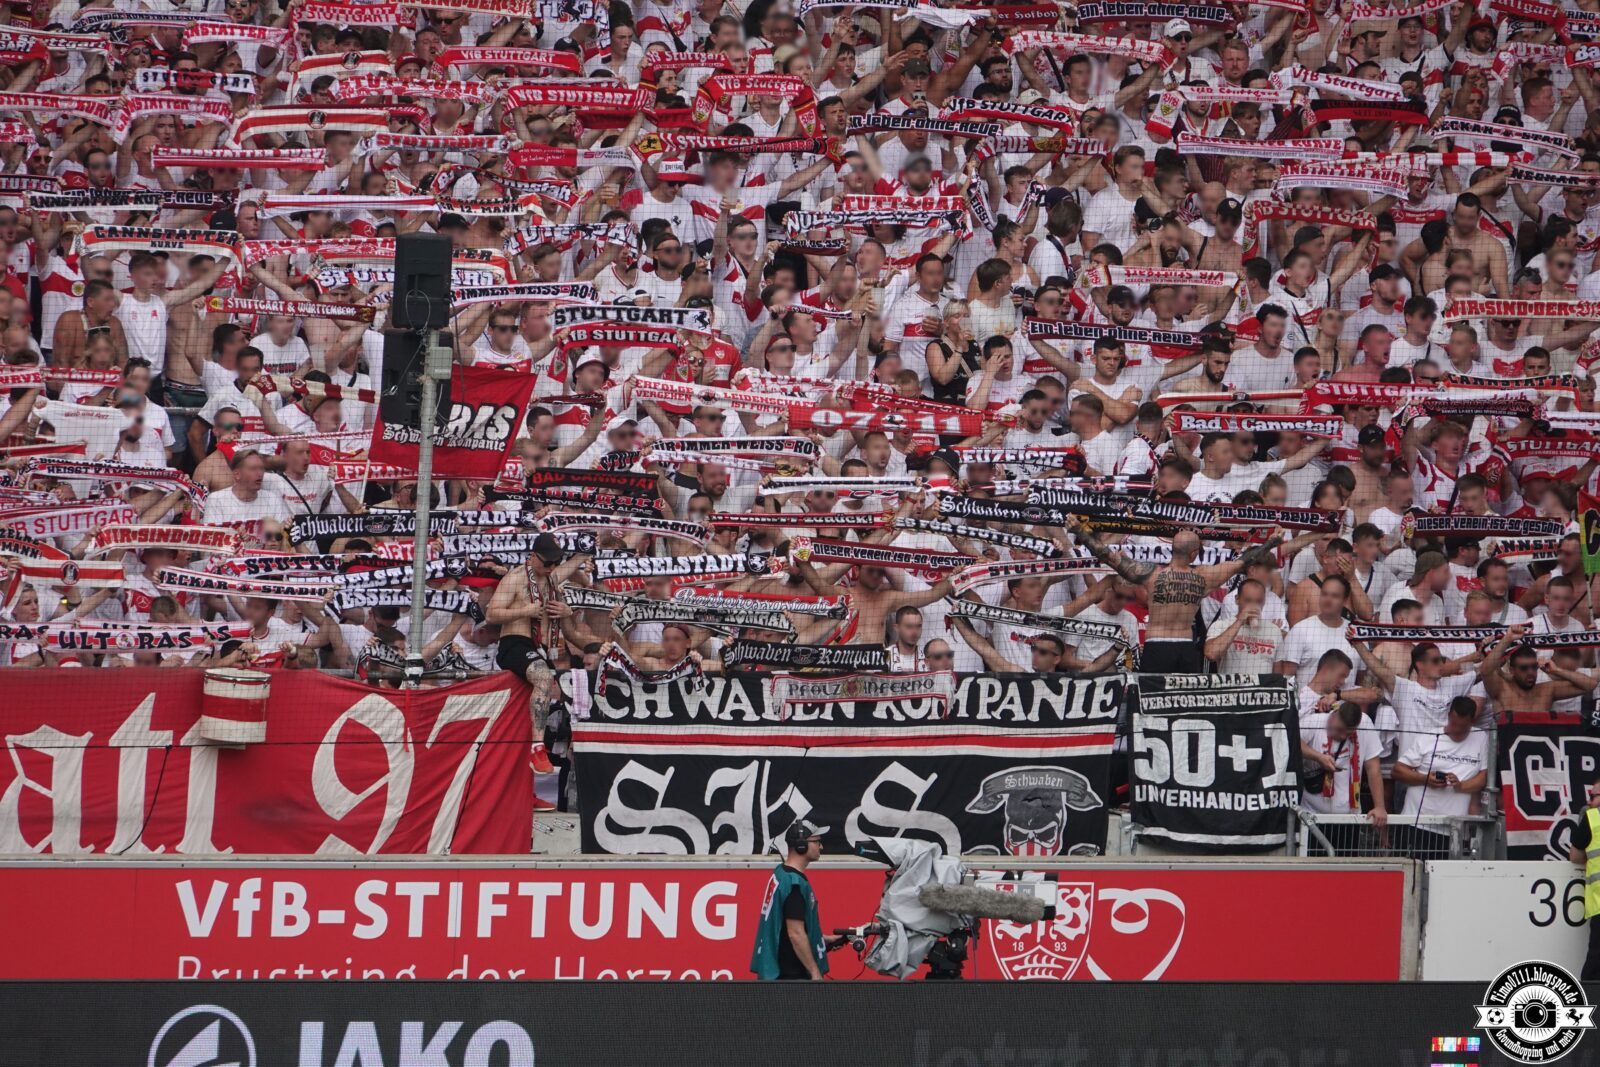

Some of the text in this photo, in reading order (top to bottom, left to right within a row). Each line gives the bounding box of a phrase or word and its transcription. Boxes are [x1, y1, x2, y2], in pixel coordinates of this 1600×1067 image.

[307, 6, 394, 24] STUTTGART
[461, 50, 557, 64] VfB STUTTGART
[666, 50, 727, 65] Stuttgart
[719, 78, 808, 95] VfB Stuttgart
[1292, 66, 1403, 100] VfB Stuttgart
[517, 90, 633, 107] VfB STUTTGART
[953, 99, 1073, 124] VfB STUTTGART
[377, 136, 497, 151] STUTTGART
[94, 226, 239, 247] CANNSTATTER
[150, 240, 185, 251] KURVE
[461, 285, 599, 301] IMMER WEISS ROT
[227, 296, 287, 312] STUTTGART
[289, 301, 297, 311] &
[1447, 303, 1570, 319] WIR SIND DER
[554, 307, 690, 327] STUTTGART
[1109, 327, 1150, 342] ohne
[636, 380, 693, 395] ERFOLGE
[636, 389, 693, 402] VERGEHEN
[1181, 415, 1339, 436] Bad Cannstatt
[384, 425, 506, 453] Schwen Kompanie
[681, 442, 725, 456] IMMER
[735, 440, 785, 456] WEISS
[547, 497, 584, 507] NEVER
[584, 502, 615, 511] WALK
[618, 505, 654, 516] ALONE
[939, 495, 1021, 519] Schwaben
[34, 507, 137, 532] STUTTGAR
[290, 514, 366, 544] Schwaben
[919, 518, 955, 535] FÜR
[96, 527, 226, 547] WIR SIND DER
[443, 532, 577, 555] KESSELSTDT
[595, 554, 749, 579] KESSELSTADT
[1060, 617, 1128, 642] KOMPA
[1356, 626, 1512, 643] CREW 36 STUTTGA
[59, 630, 193, 650] ULTRAS
[1538, 635, 1557, 648] 36
[725, 643, 793, 668] Schwaben
[789, 681, 842, 698] PFALZ
[1165, 676, 1261, 694] EHRE ALLEN
[1140, 690, 1288, 711] VERSTORBENEN ULTRAS
[1134, 713, 1298, 792] 50+1
[1004, 772, 1064, 790] Schwaben
[1134, 783, 1300, 813] UNVERHANDELBAR
[175, 877, 739, 941] VfB-STIFTUNG
[1529, 877, 1586, 929] 36
[1012, 942, 1067, 952] 18 93
[300, 1019, 534, 1067] JAKO
